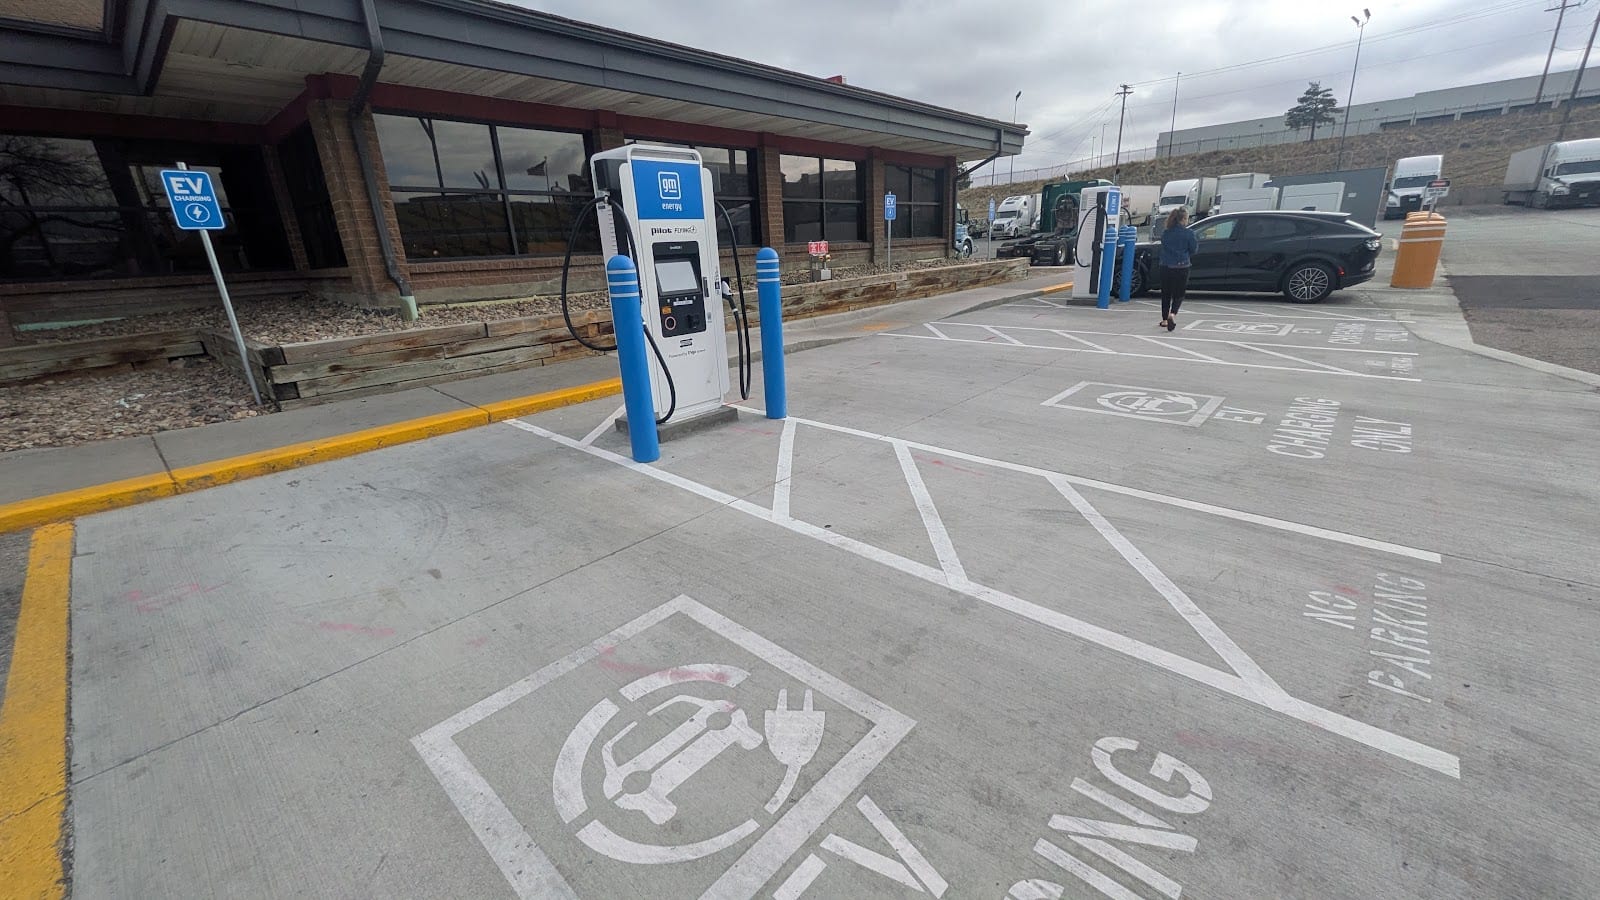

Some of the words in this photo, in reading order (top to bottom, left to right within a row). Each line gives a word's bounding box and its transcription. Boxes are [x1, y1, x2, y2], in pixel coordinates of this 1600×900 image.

[169, 177, 203, 195] EV
[662, 178, 678, 193] gm
[661, 203, 683, 212] energy
[651, 227, 673, 236] pilot
[1213, 406, 1267, 424] EV
[1266, 397, 1341, 459] CHARGING
[1350, 416, 1412, 453] ONLY
[1303, 590, 1357, 629] NO
[1367, 572, 1432, 703] PARKING
